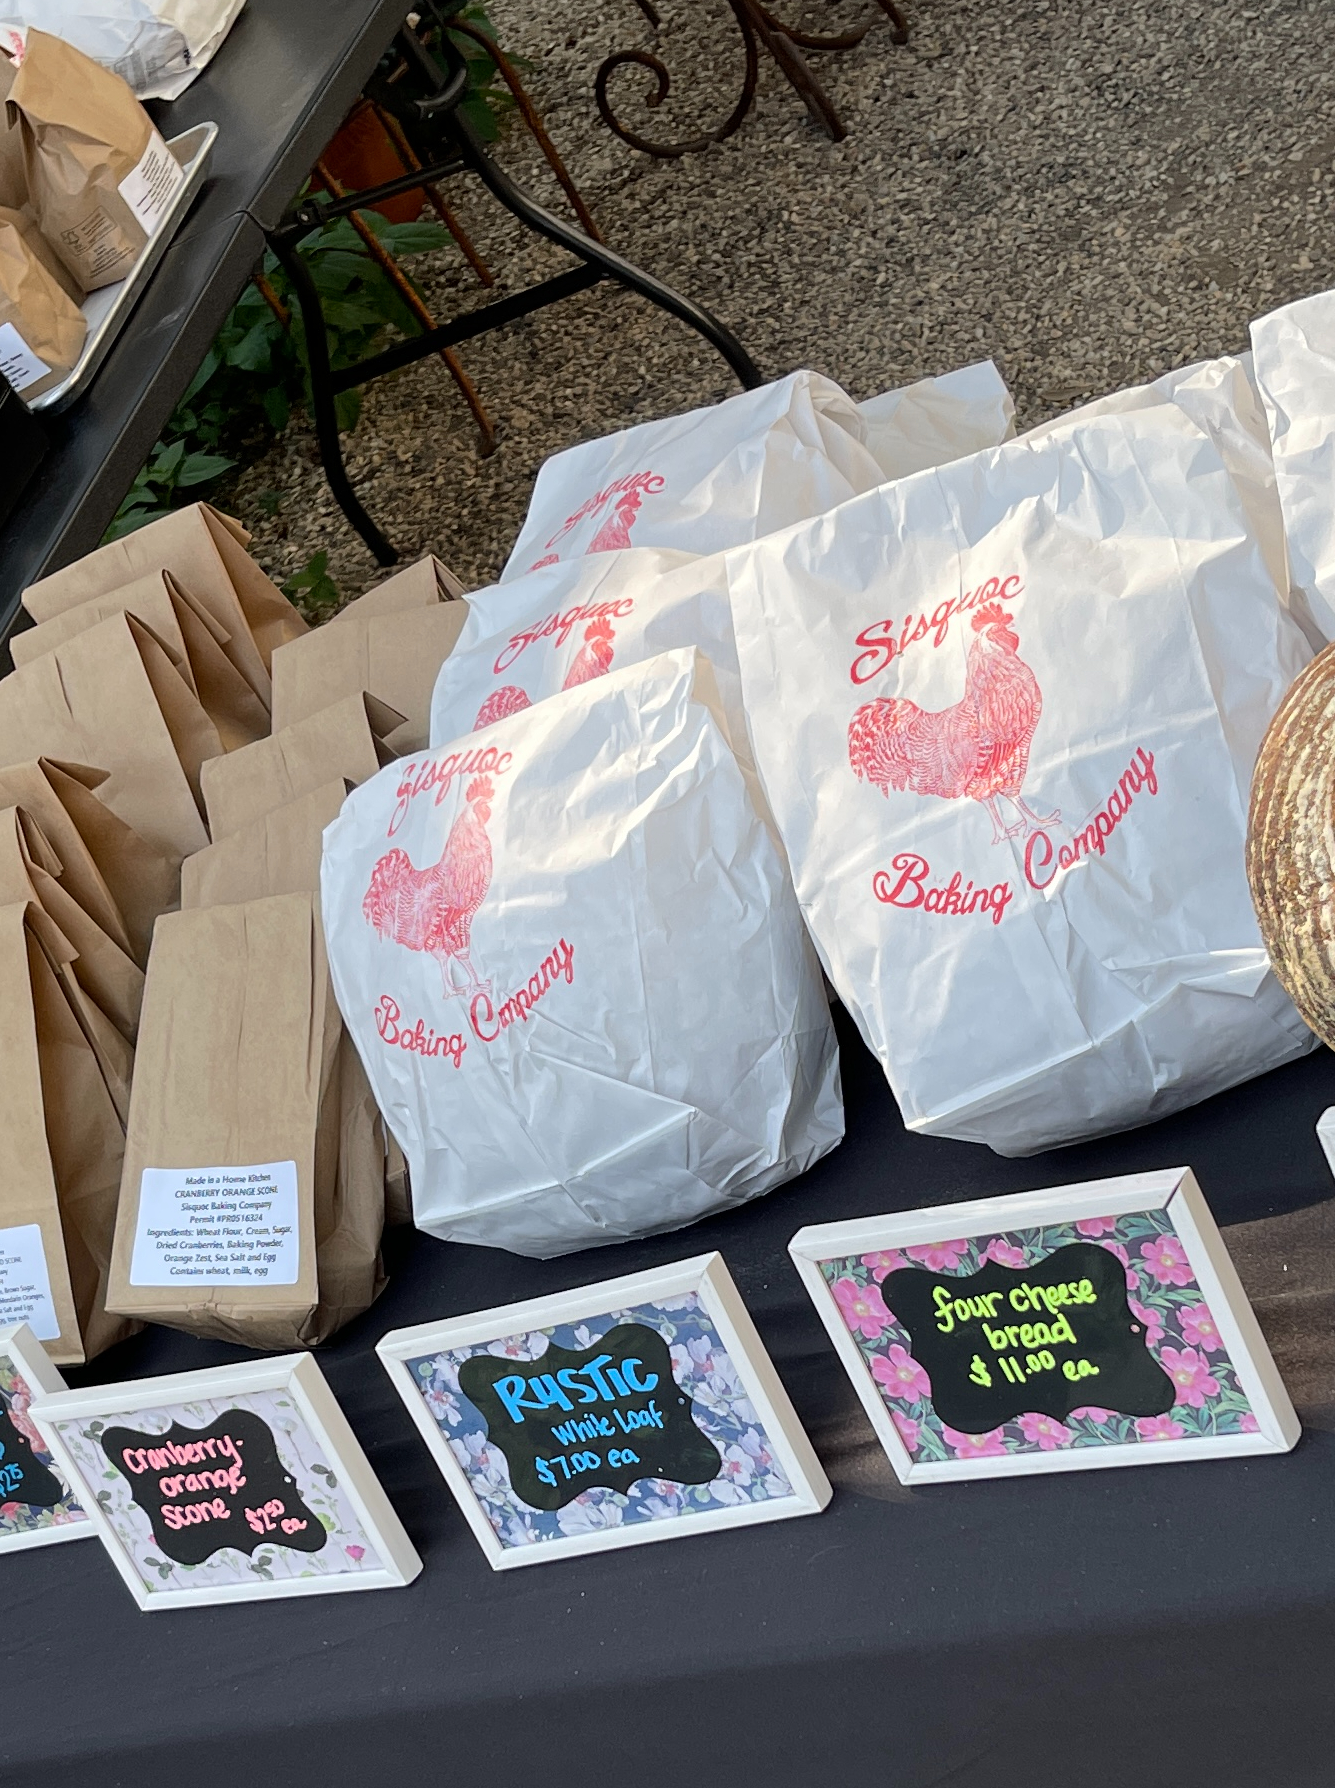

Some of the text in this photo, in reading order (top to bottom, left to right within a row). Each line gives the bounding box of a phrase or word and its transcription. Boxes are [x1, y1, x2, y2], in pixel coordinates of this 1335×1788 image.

[545, 470, 665, 549] Sisquoc
[493, 598, 634, 675] Sisquoc
[850, 574, 1025, 685] Sisquoc
[387, 747, 513, 838] Sisquoc
[872, 746, 1158, 924] Baking Company
[374, 995, 467, 1070] Baking
[175, 1185, 278, 1198] CRANBERRY ORANGE SCONE
[185, 1176, 206, 1185] Made
[207, 1176, 214, 1184] in
[222, 1175, 246, 1183] Home
[248, 1173, 271, 1182] Kitchen
[181, 1201, 272, 1213] Sisquoc Baking Company
[189, 1215, 215, 1224] Permit
[156, 1241, 178, 1249] Dried
[227, 1240, 254, 1250] Baking
[196, 1228, 221, 1236] Wheat
[164, 1254, 193, 1264] Orange
[215, 1254, 228, 1262] Sea
[230, 1253, 245, 1262] Salt
[247, 1253, 262, 1261] and
[263, 1253, 276, 1262] Egg
[170, 1267, 204, 1275] Contains
[254, 1268, 268, 1276] egg
[932, 1279, 1097, 1333] four cheese
[982, 1313, 1077, 1351] bread
[1062, 1358, 1100, 1381] ea
[159, 1466, 246, 1498] orange
[535, 1448, 640, 1487] $7.00 ea
[161, 1498, 231, 1530] scone
[280, 1517, 308, 1534] ea
